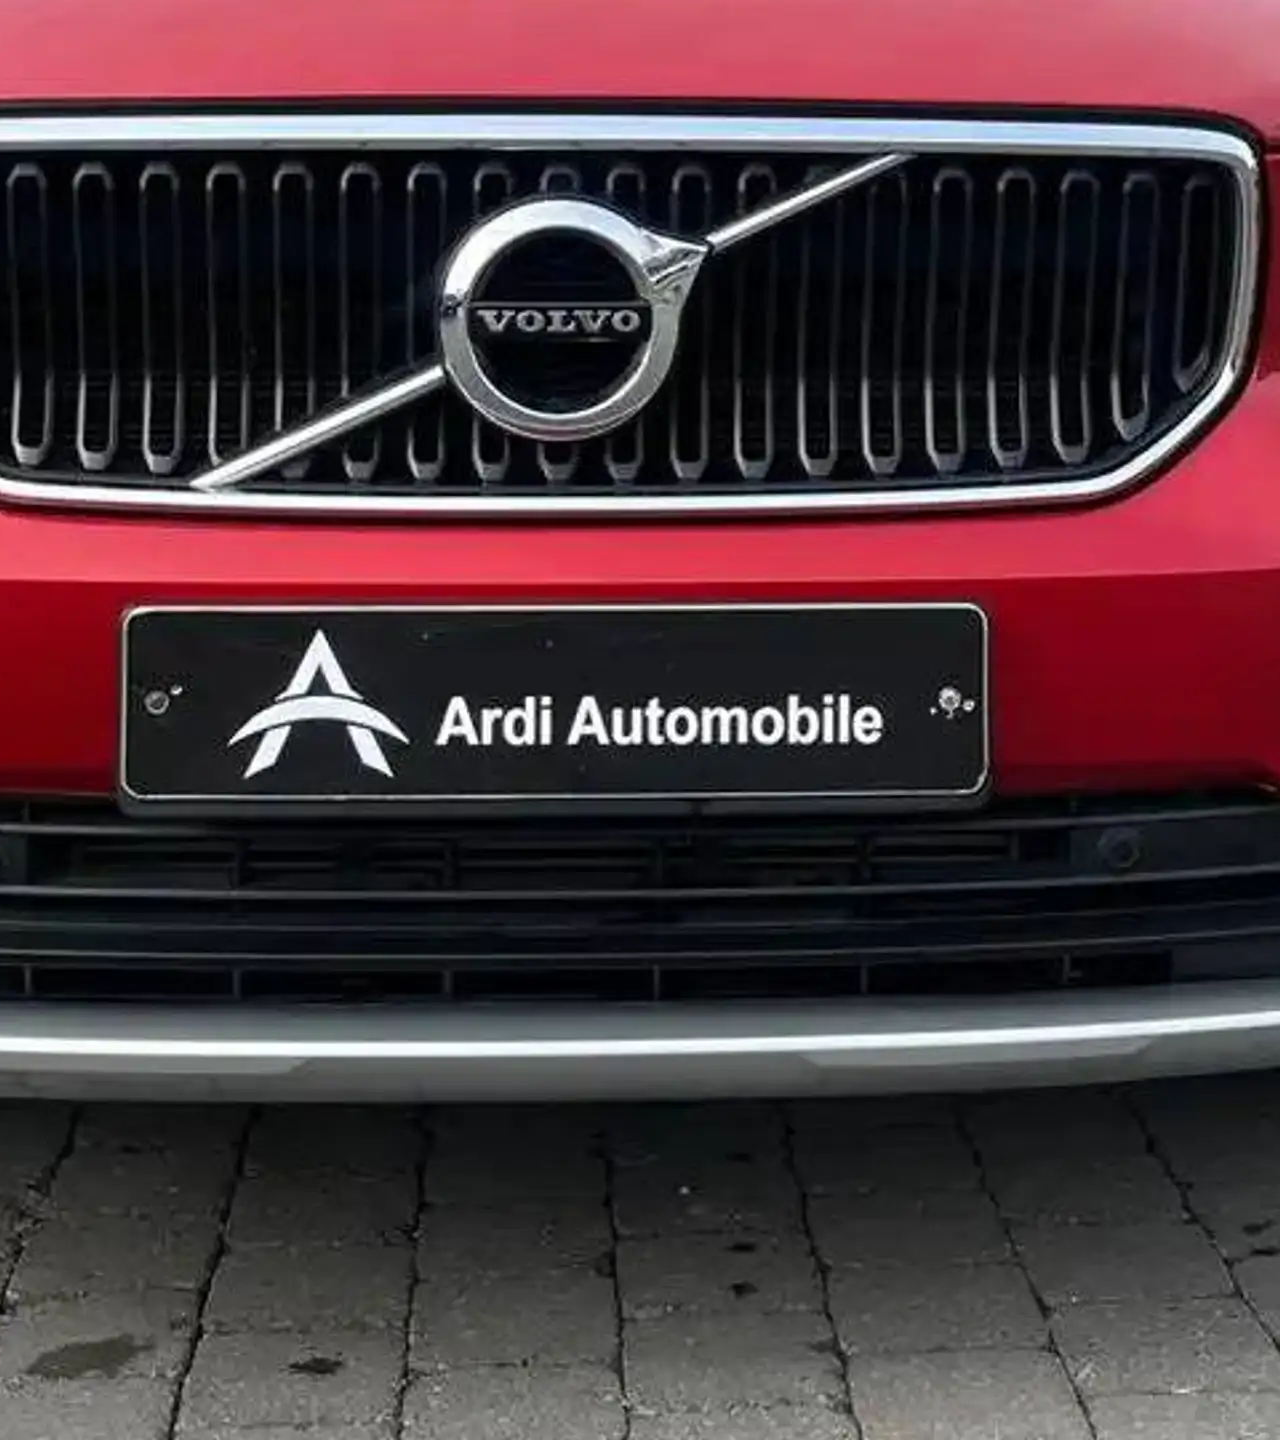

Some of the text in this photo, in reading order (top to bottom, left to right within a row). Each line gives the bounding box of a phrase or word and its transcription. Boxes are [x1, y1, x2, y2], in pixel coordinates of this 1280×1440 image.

[477, 309, 641, 332] VOLVO
[435, 693, 883, 745] Ardi Automobile
